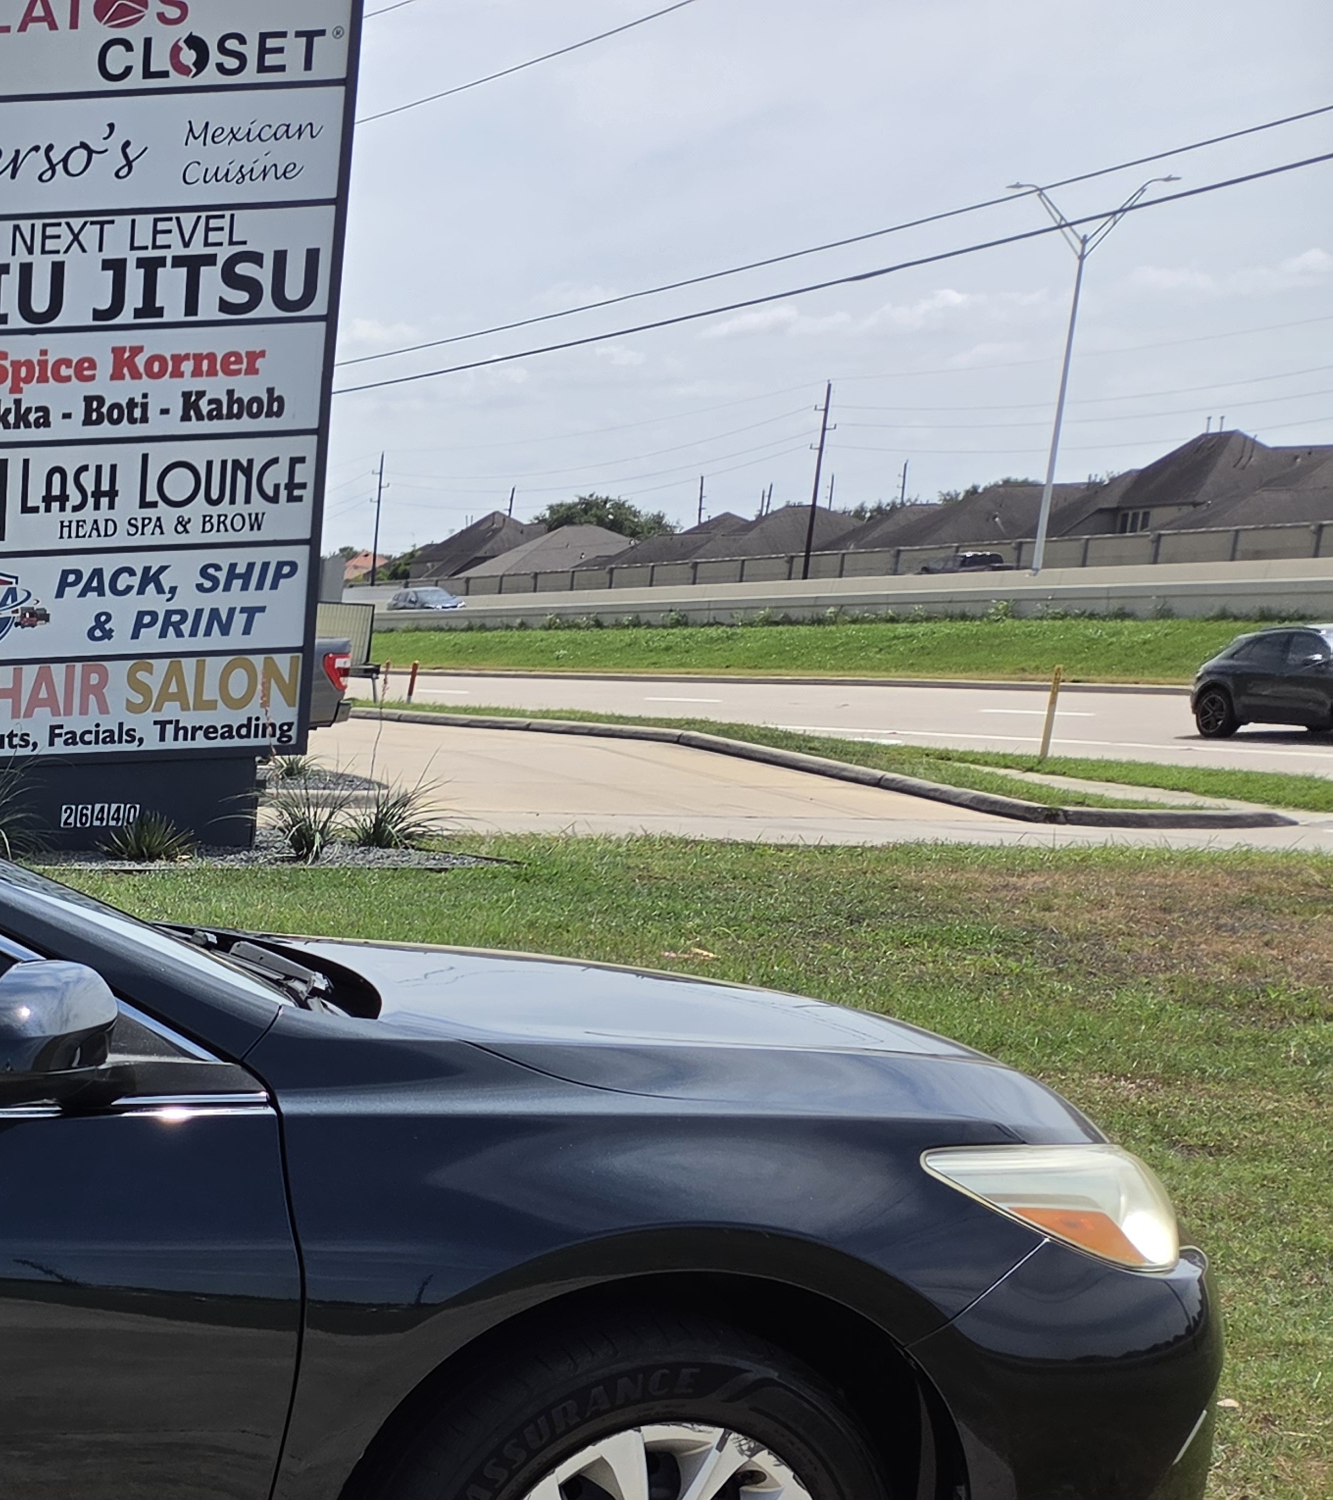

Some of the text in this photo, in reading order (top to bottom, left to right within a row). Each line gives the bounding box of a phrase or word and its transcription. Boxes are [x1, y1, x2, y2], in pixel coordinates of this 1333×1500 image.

[97, 29, 327, 82] CLOSET
[185, 119, 323, 147] Mexican
[182, 151, 304, 185] Cuisine
[11, 214, 247, 256] NEXT LEVEL
[92, 248, 321, 322] JITSU
[109, 346, 266, 381] Korner
[82, 393, 150, 427] Boti
[181, 387, 286, 422] Kabob
[139, 453, 308, 509] LOUNGE
[58, 511, 266, 539] HEAD SPA & BROW
[55, 560, 298, 602] PACK, SHIP
[87, 606, 266, 641] & PRINT
[125, 655, 300, 712] SALON
[48, 723, 144, 748] Facials,
[153, 716, 295, 746] Threading
[61, 804, 139, 828] 26440
